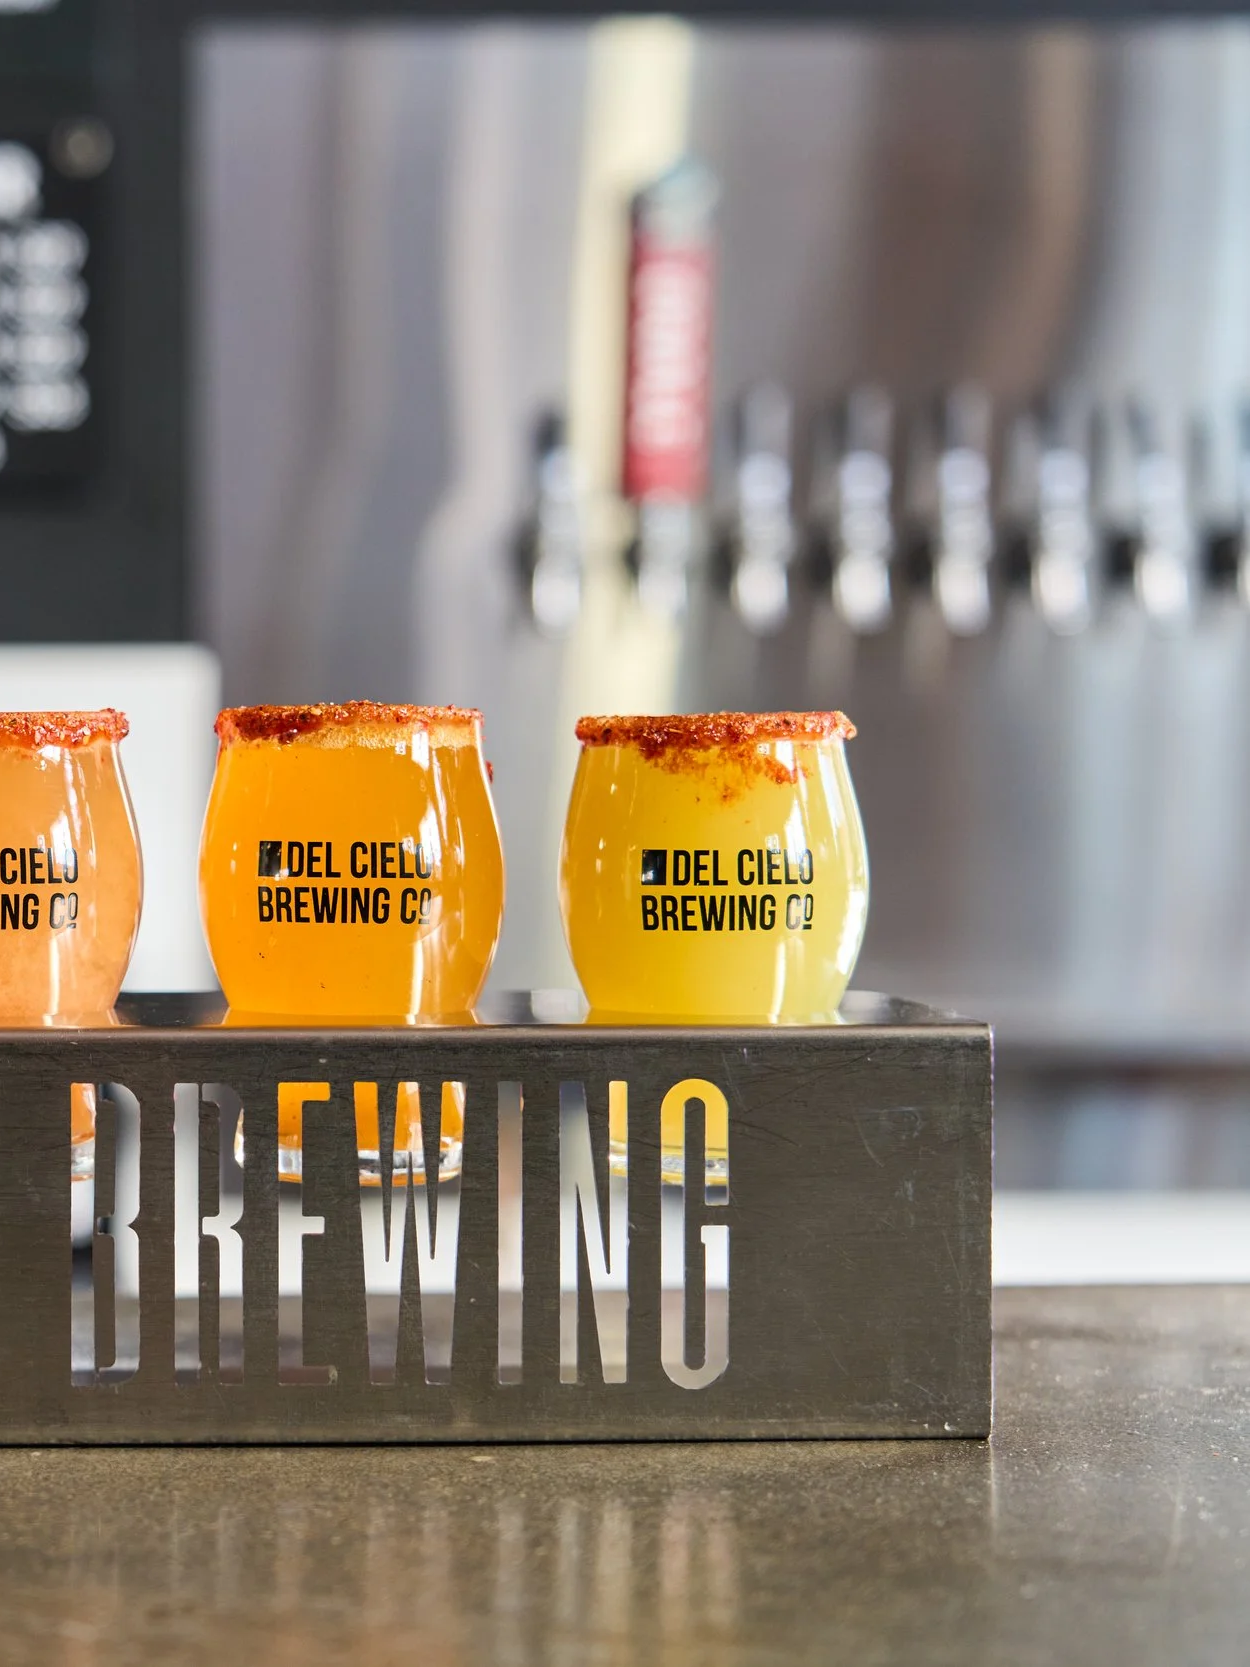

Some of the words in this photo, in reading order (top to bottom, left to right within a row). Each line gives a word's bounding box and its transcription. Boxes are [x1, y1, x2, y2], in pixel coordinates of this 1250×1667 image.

[0, 848, 79, 884] CIELO
[287, 841, 341, 878] DEL
[672, 850, 728, 886] DEL
[737, 849, 814, 885] CIELO
[258, 886, 390, 924] BREWING
[641, 894, 776, 931] BREWING
[70, 1079, 729, 1389] BREWING
